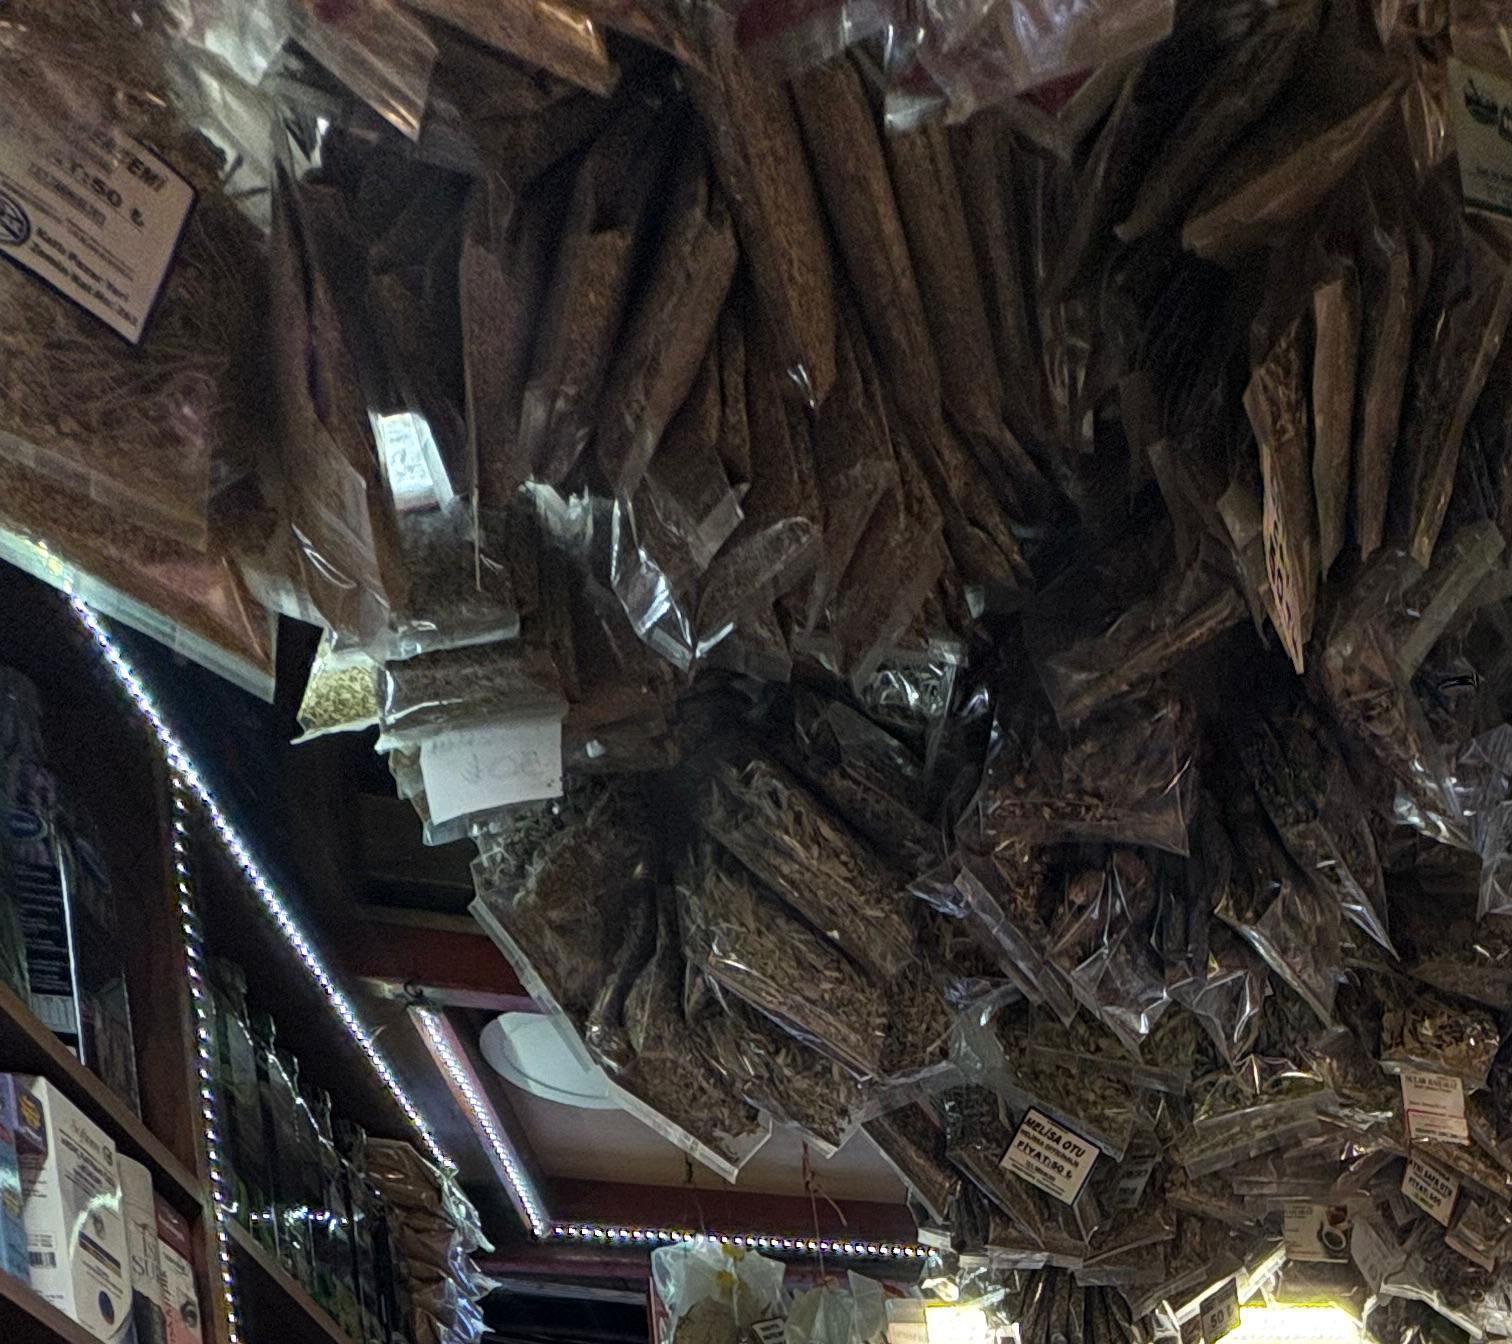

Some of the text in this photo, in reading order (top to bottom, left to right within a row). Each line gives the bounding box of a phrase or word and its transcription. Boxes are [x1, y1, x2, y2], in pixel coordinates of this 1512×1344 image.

[1024, 1117, 1086, 1158] MELİSA OTU
[1210, 1310, 1224, 1328] 50
